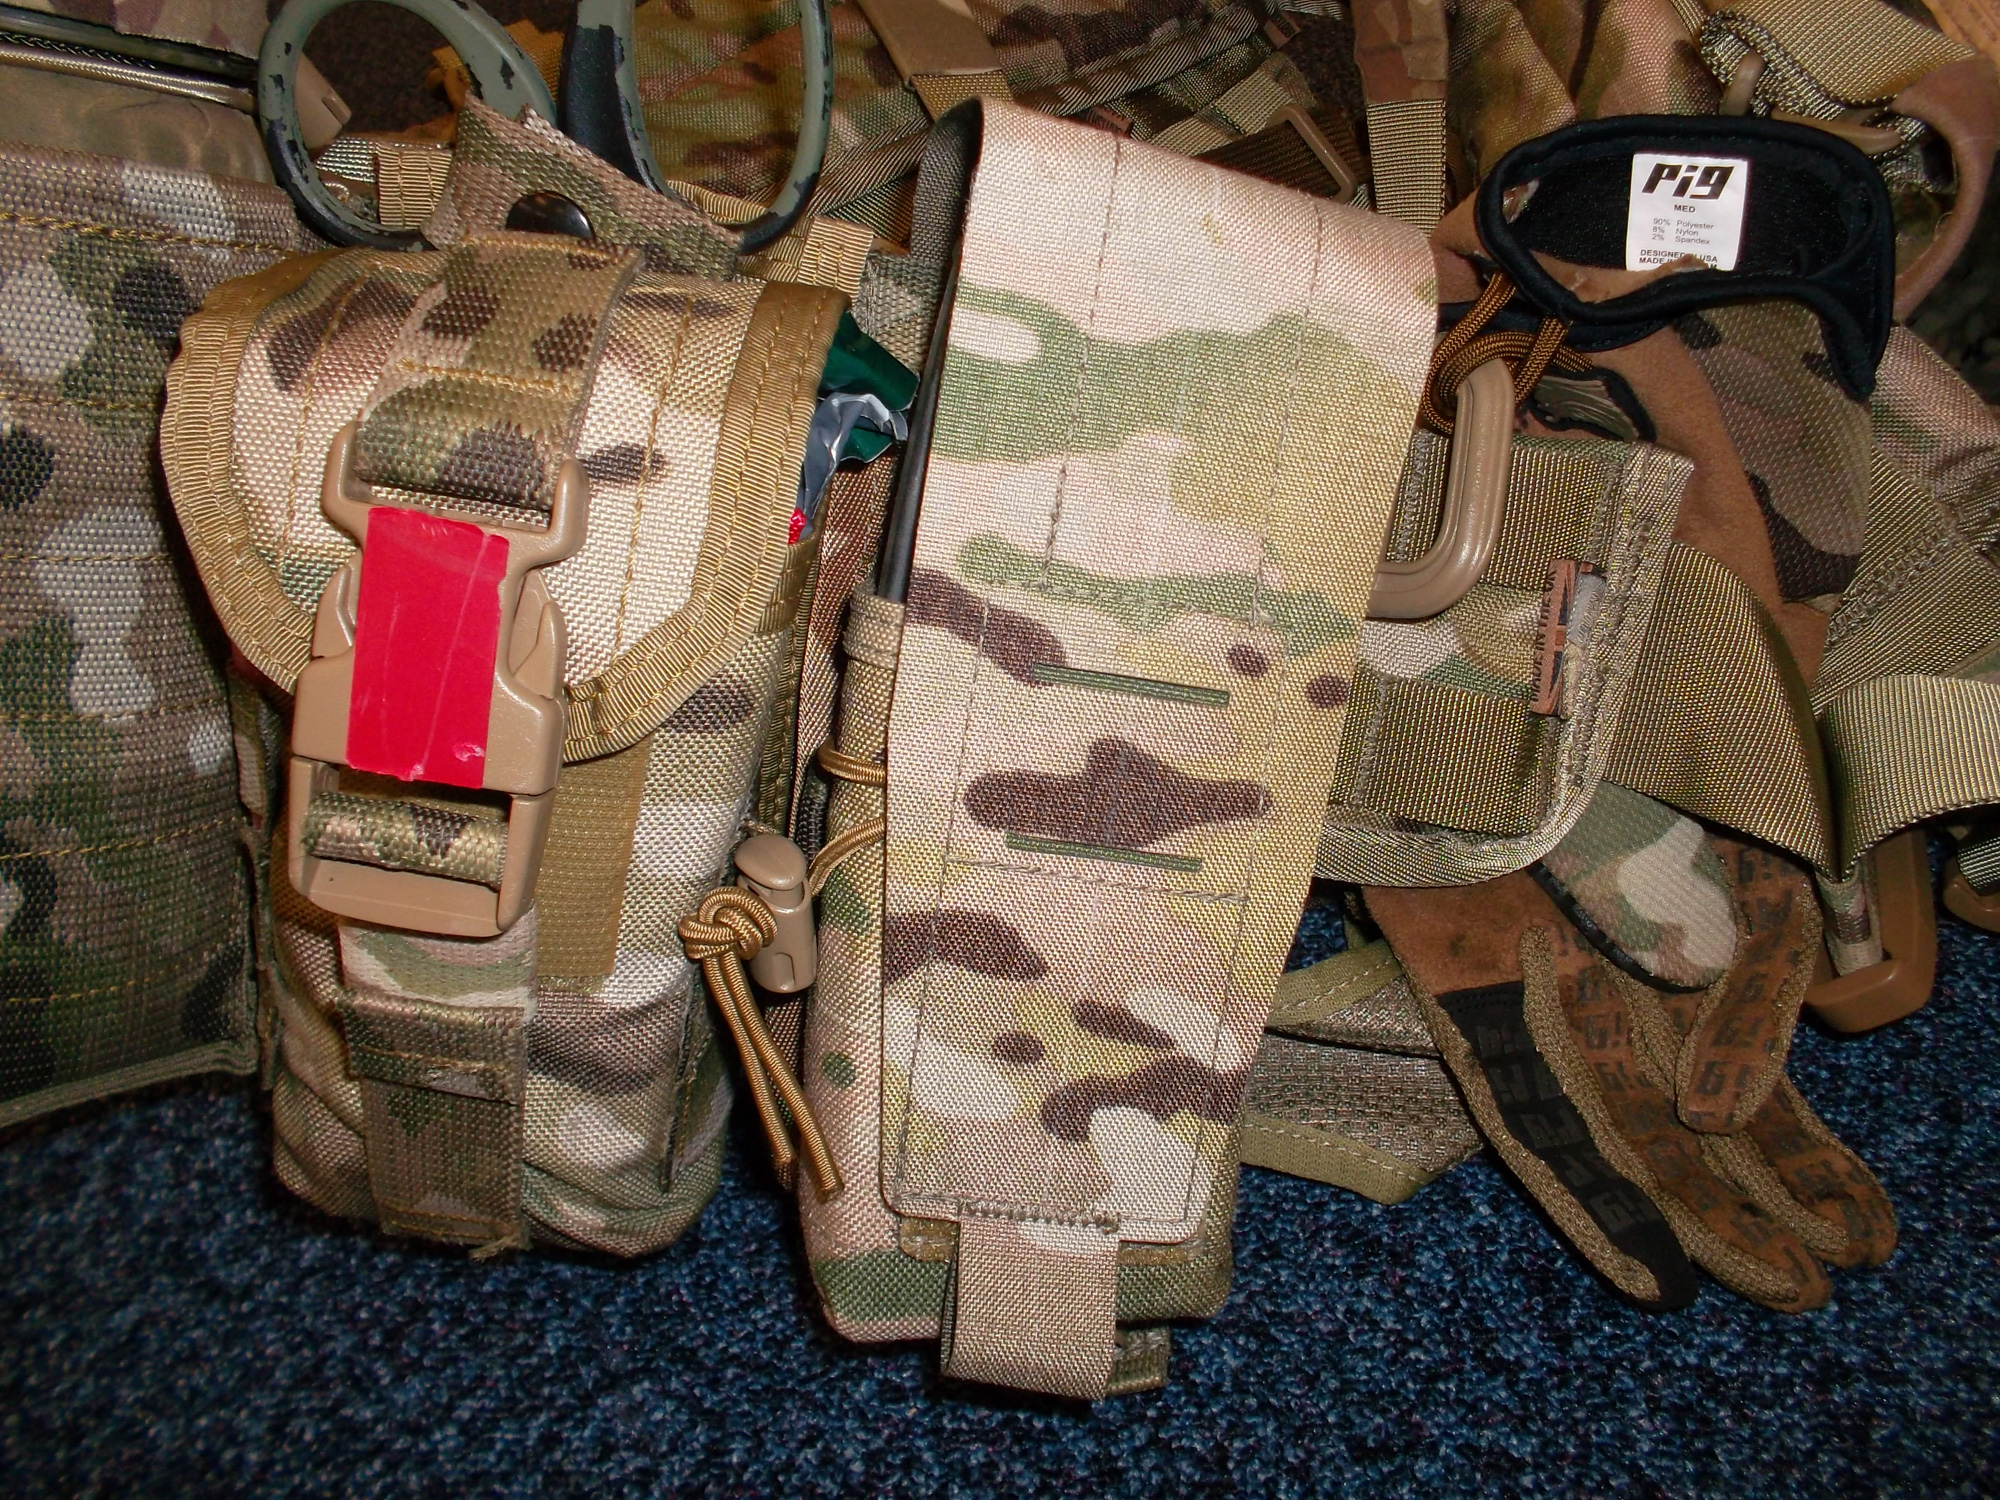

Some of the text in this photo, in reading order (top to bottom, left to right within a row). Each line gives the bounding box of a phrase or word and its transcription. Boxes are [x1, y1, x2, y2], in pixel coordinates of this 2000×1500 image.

[1674, 204, 1696, 213] MED
[1653, 217, 1714, 230] 90% Polyester
[1652, 225, 1699, 237] 8% Nylon
[1652, 233, 1710, 245] 2% Spandex
[1639, 257, 1664, 265] MADE
[1699, 254, 1718, 263] USA
